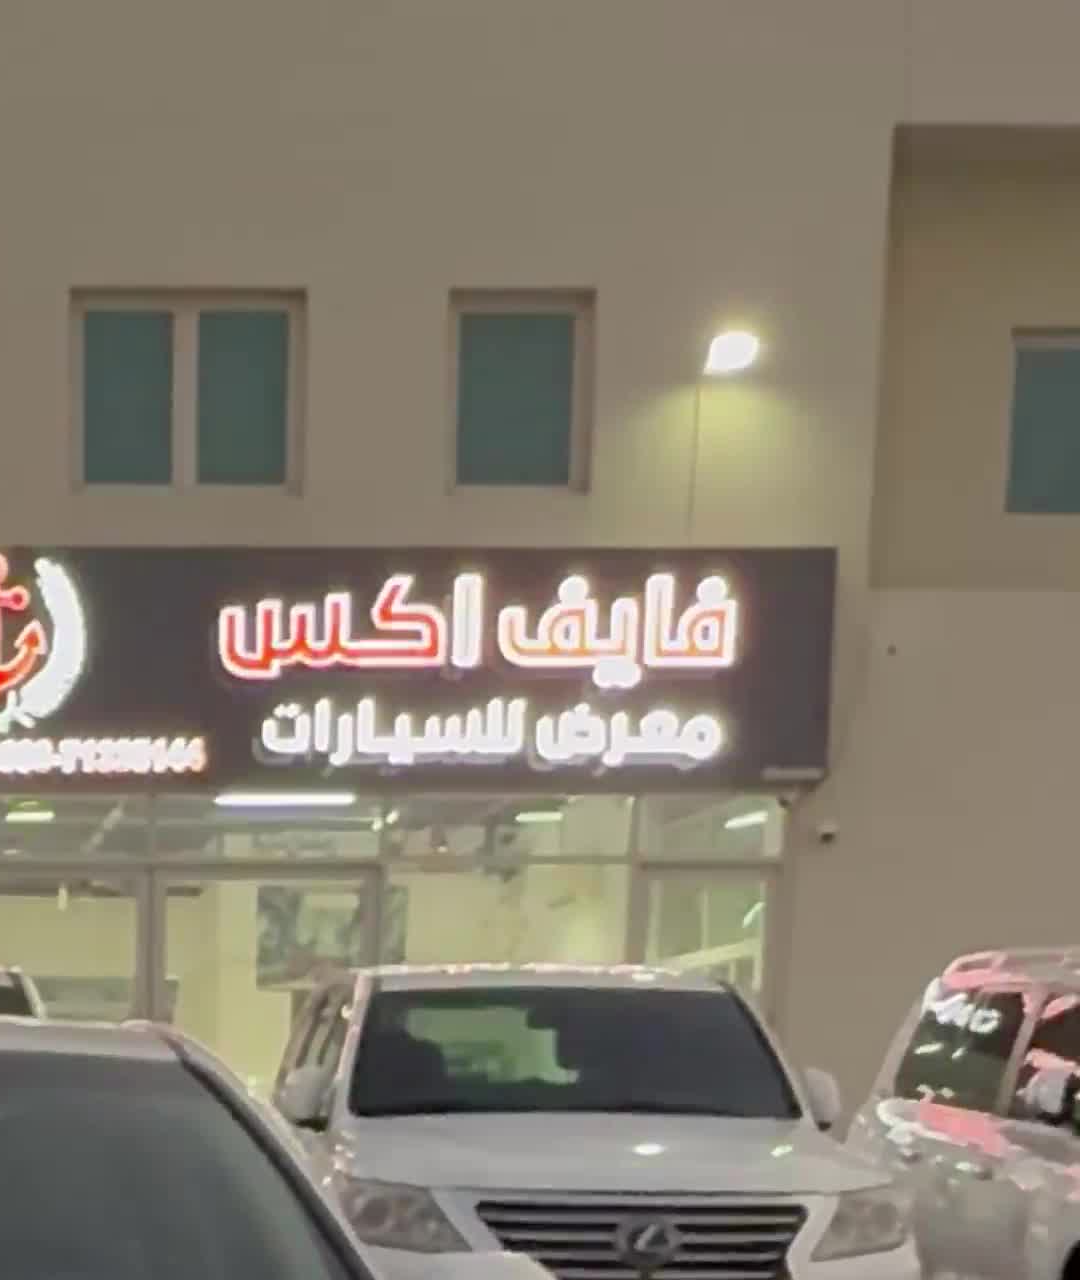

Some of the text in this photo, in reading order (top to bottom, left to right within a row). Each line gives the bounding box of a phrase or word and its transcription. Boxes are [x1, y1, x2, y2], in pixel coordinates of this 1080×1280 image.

[219, 573, 738, 688] فايف اكس
[261, 697, 528, 767] للسيارات
[535, 703, 723, 766] معرض
